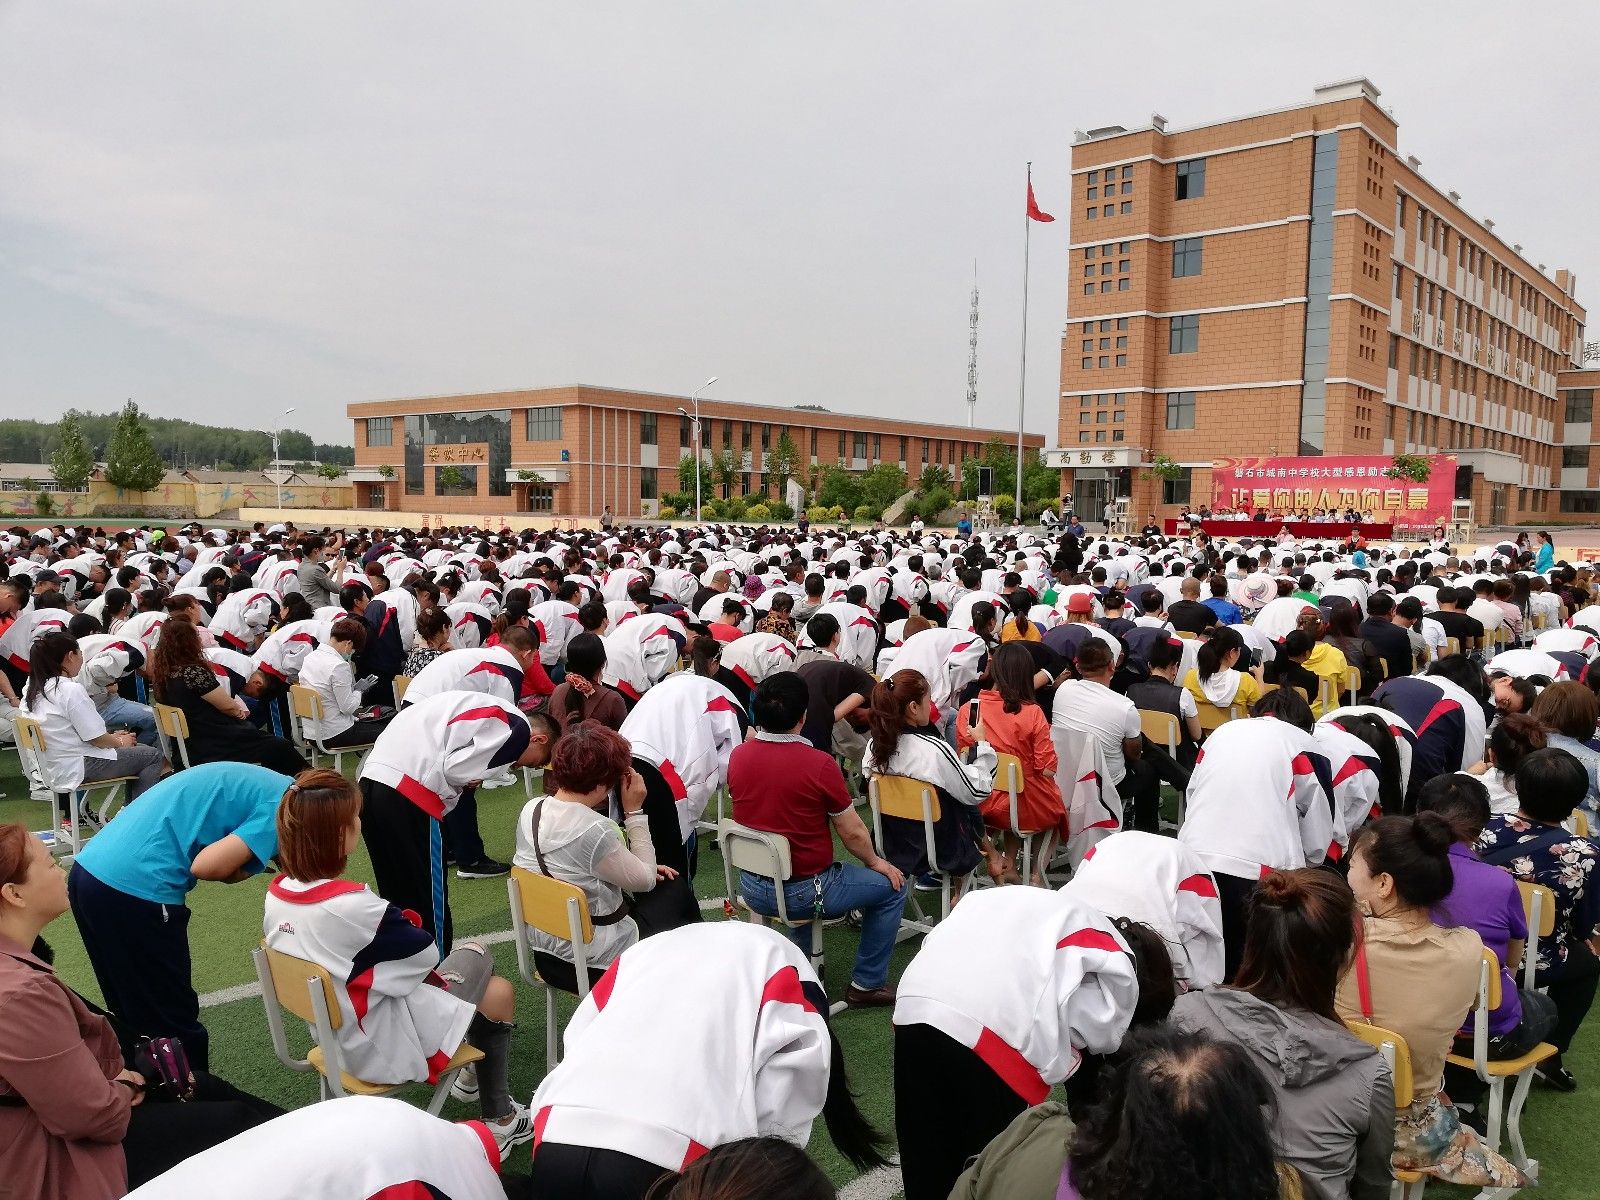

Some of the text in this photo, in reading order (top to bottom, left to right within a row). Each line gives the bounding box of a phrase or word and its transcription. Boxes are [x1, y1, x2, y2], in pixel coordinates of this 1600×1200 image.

[1234, 466, 1416, 479] 磐石市城南中学校大型感恩励志
[1230, 487, 1429, 511] 让爱你的人为你自豪
